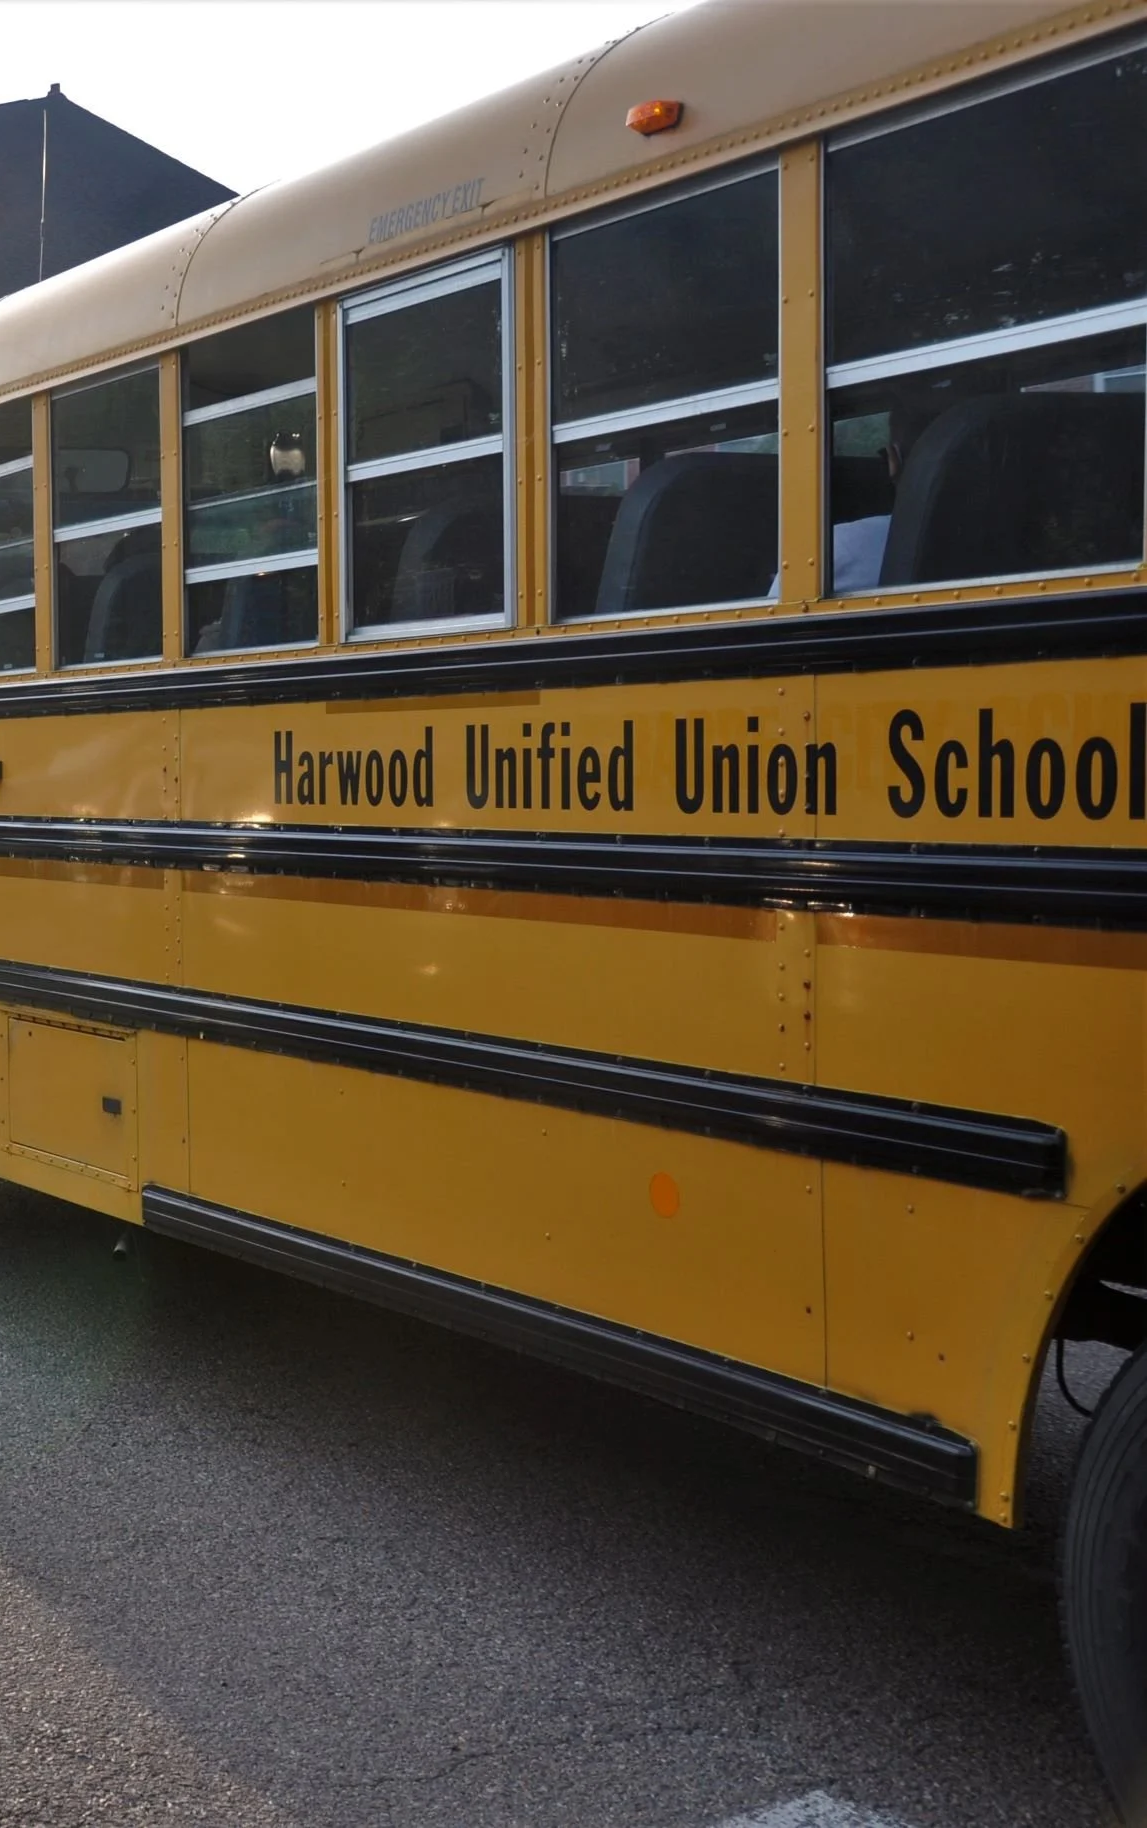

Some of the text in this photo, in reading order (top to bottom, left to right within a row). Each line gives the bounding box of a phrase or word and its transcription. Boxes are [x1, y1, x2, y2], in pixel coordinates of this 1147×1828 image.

[368, 178, 485, 244] EMERGENCY EXIT
[274, 702, 1147, 821] Harwood Unified Union School
